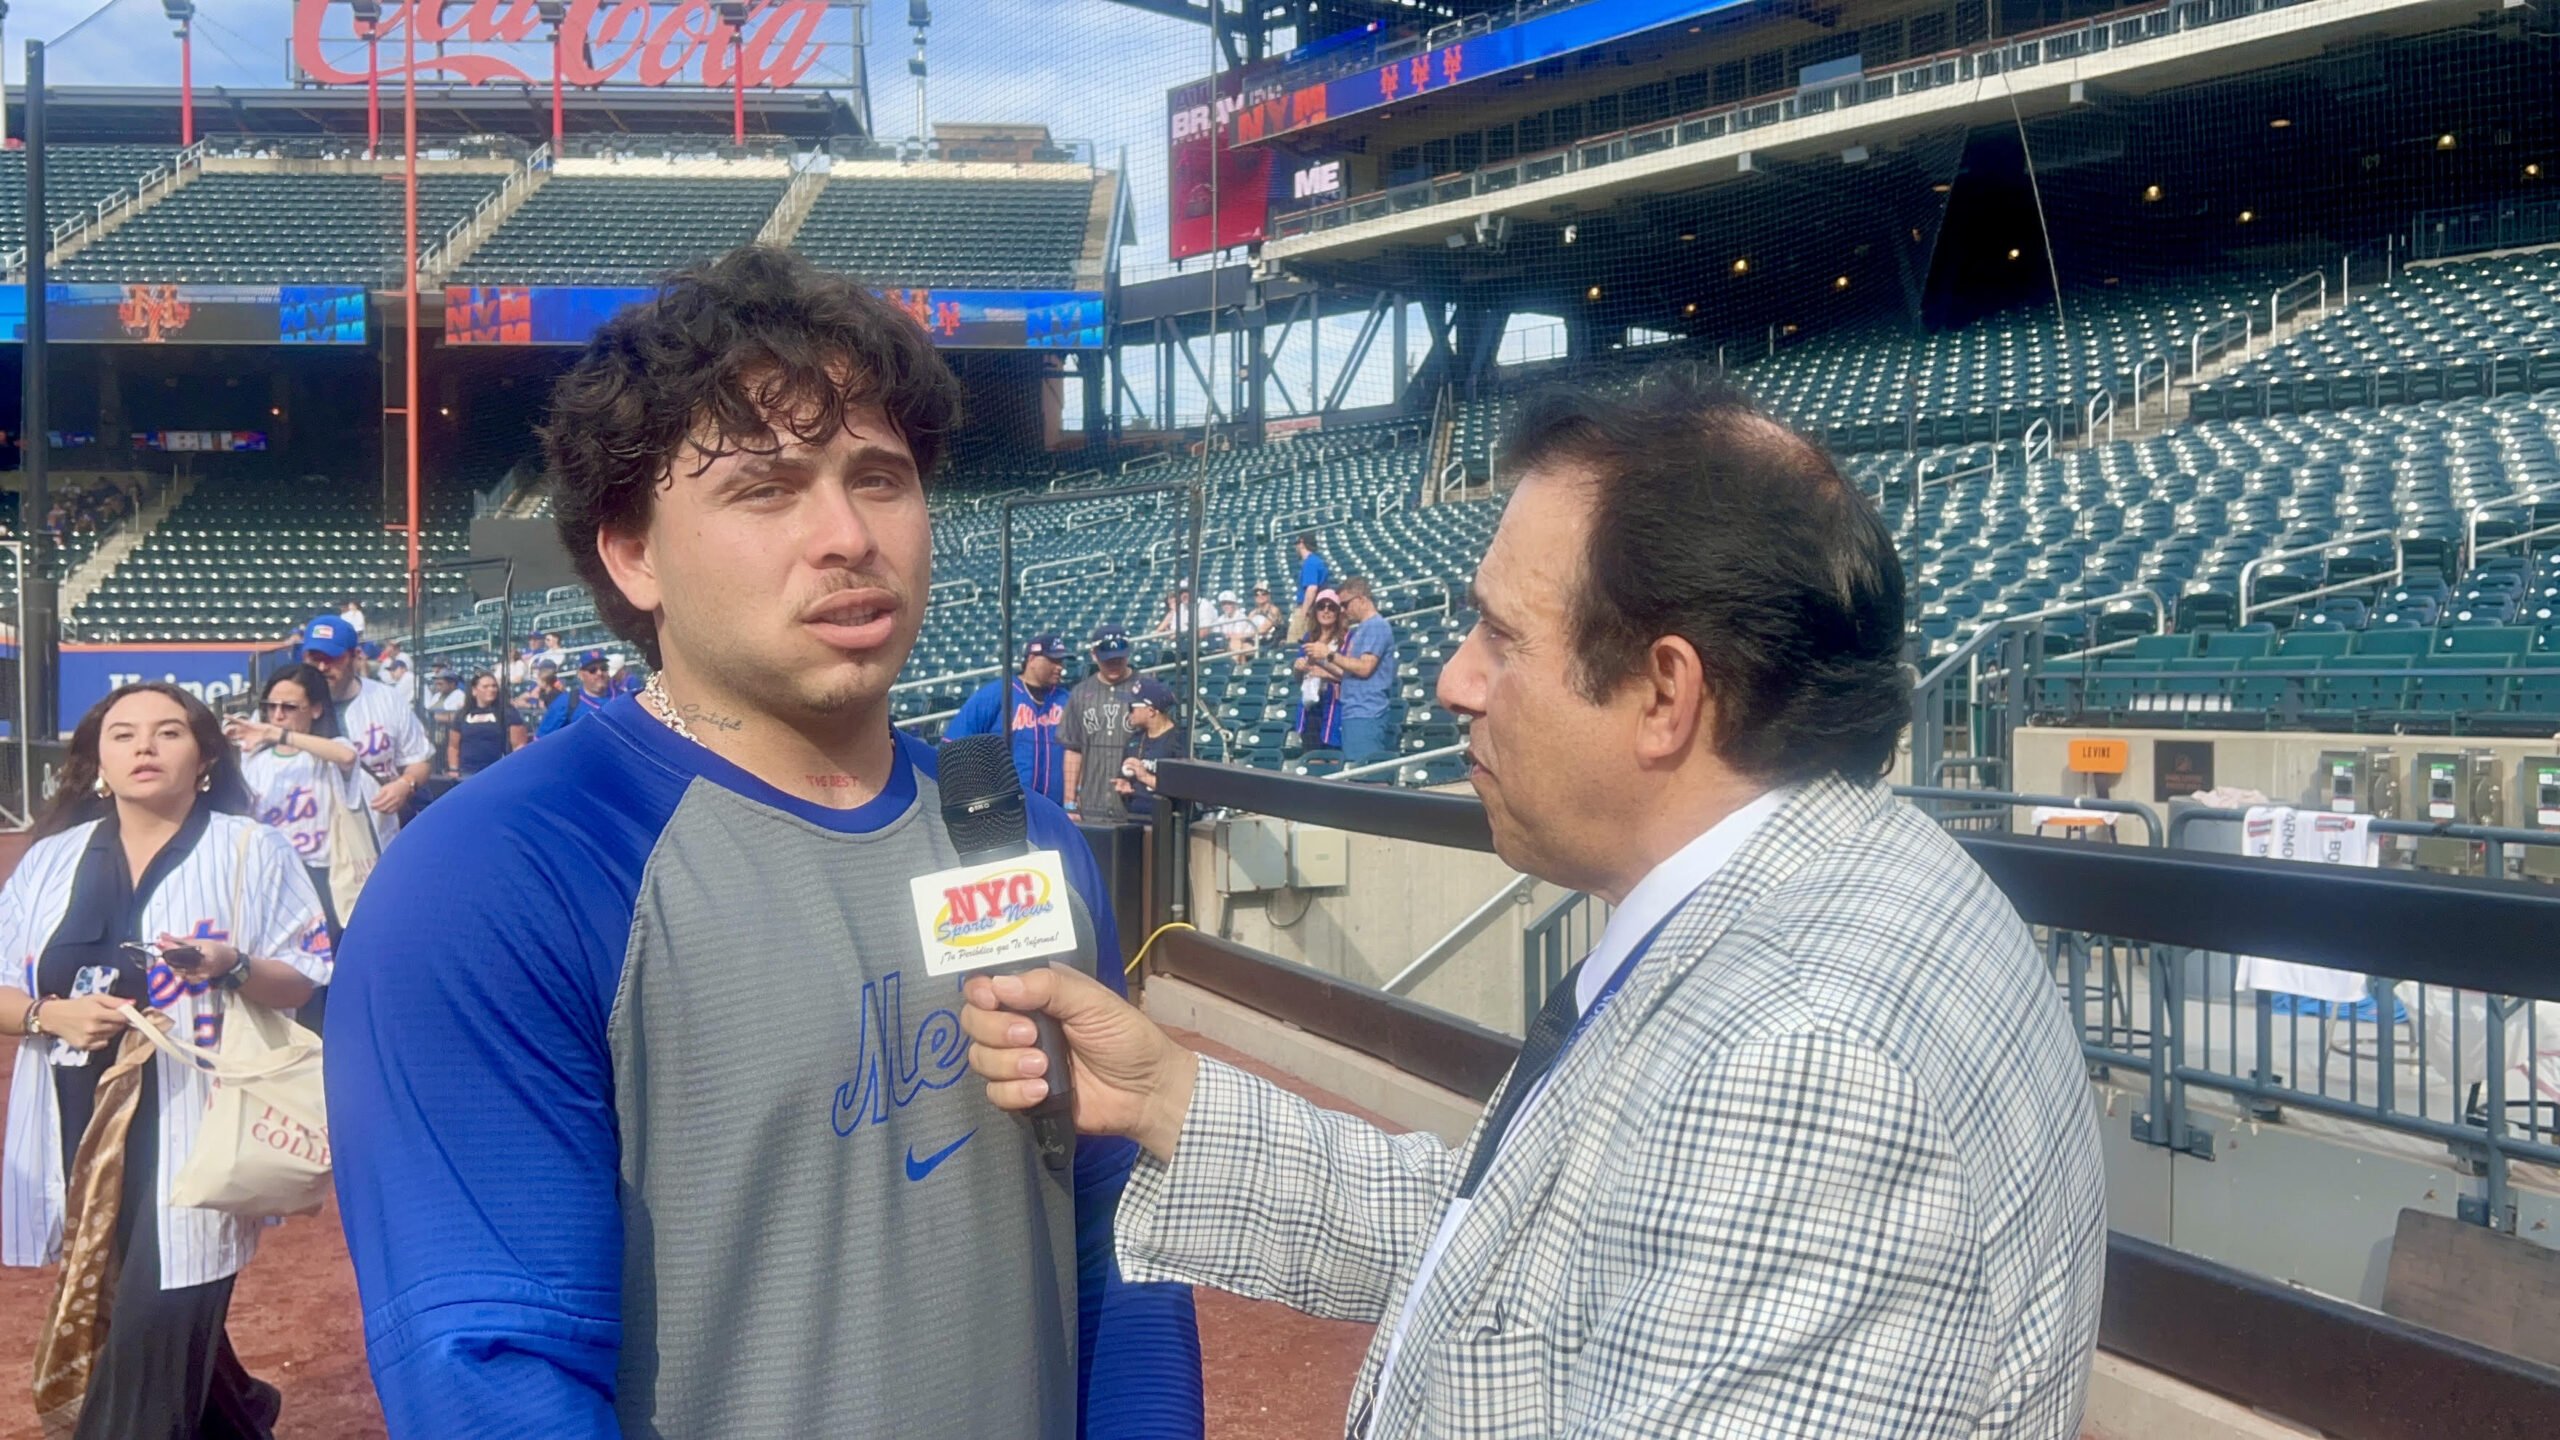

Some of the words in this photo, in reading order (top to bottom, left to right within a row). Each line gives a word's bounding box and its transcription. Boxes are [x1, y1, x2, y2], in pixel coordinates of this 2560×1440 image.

[1238, 83, 1327, 143] NYM
[2082, 746, 2111, 759] LEVINE
[936, 916, 997, 945] Sports
[1003, 900, 1053, 924] News
[944, 872, 1036, 926] NYC
